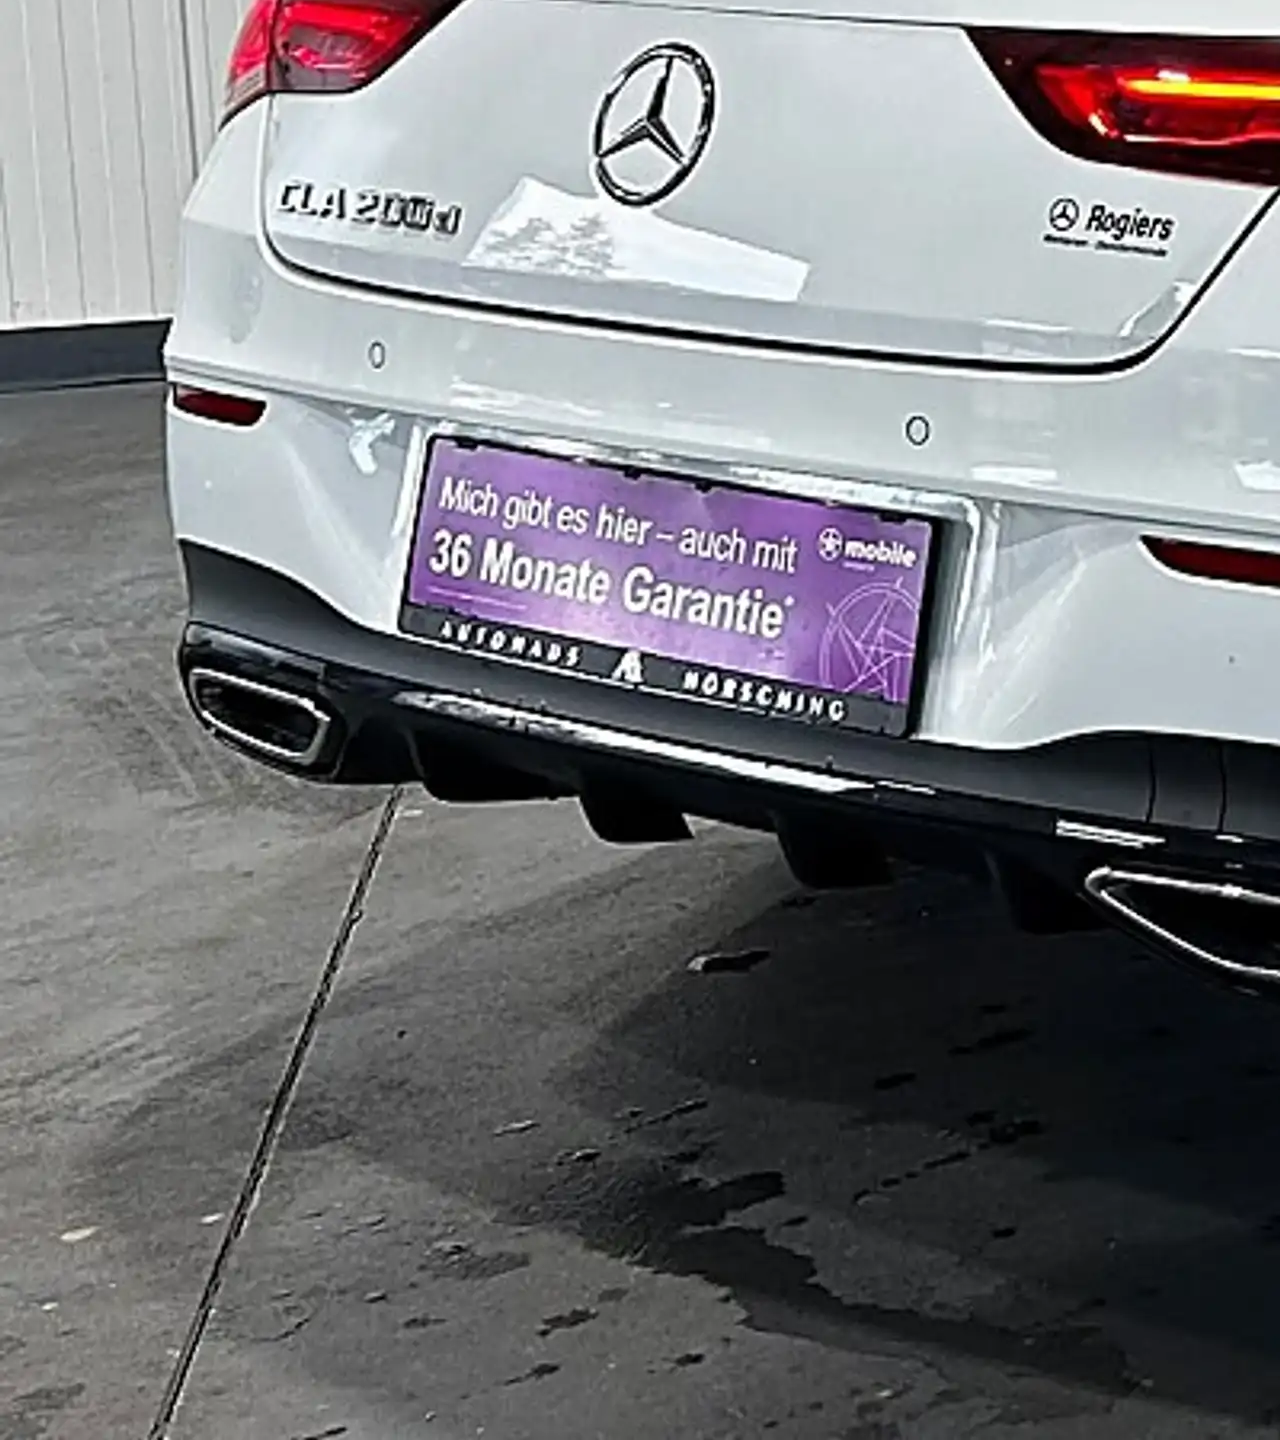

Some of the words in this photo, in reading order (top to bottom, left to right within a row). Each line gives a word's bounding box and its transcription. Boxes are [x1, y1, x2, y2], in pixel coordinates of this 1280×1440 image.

[279, 182, 346, 219] CLA
[1085, 204, 1175, 241] Rogiers
[438, 476, 499, 519] Mich
[502, 489, 553, 530] gibt
[556, 504, 591, 535] es
[594, 503, 653, 546] hier
[678, 527, 747, 565] auch
[752, 535, 798, 574] mit
[428, 528, 473, 578] 36
[479, 537, 611, 605] Monate
